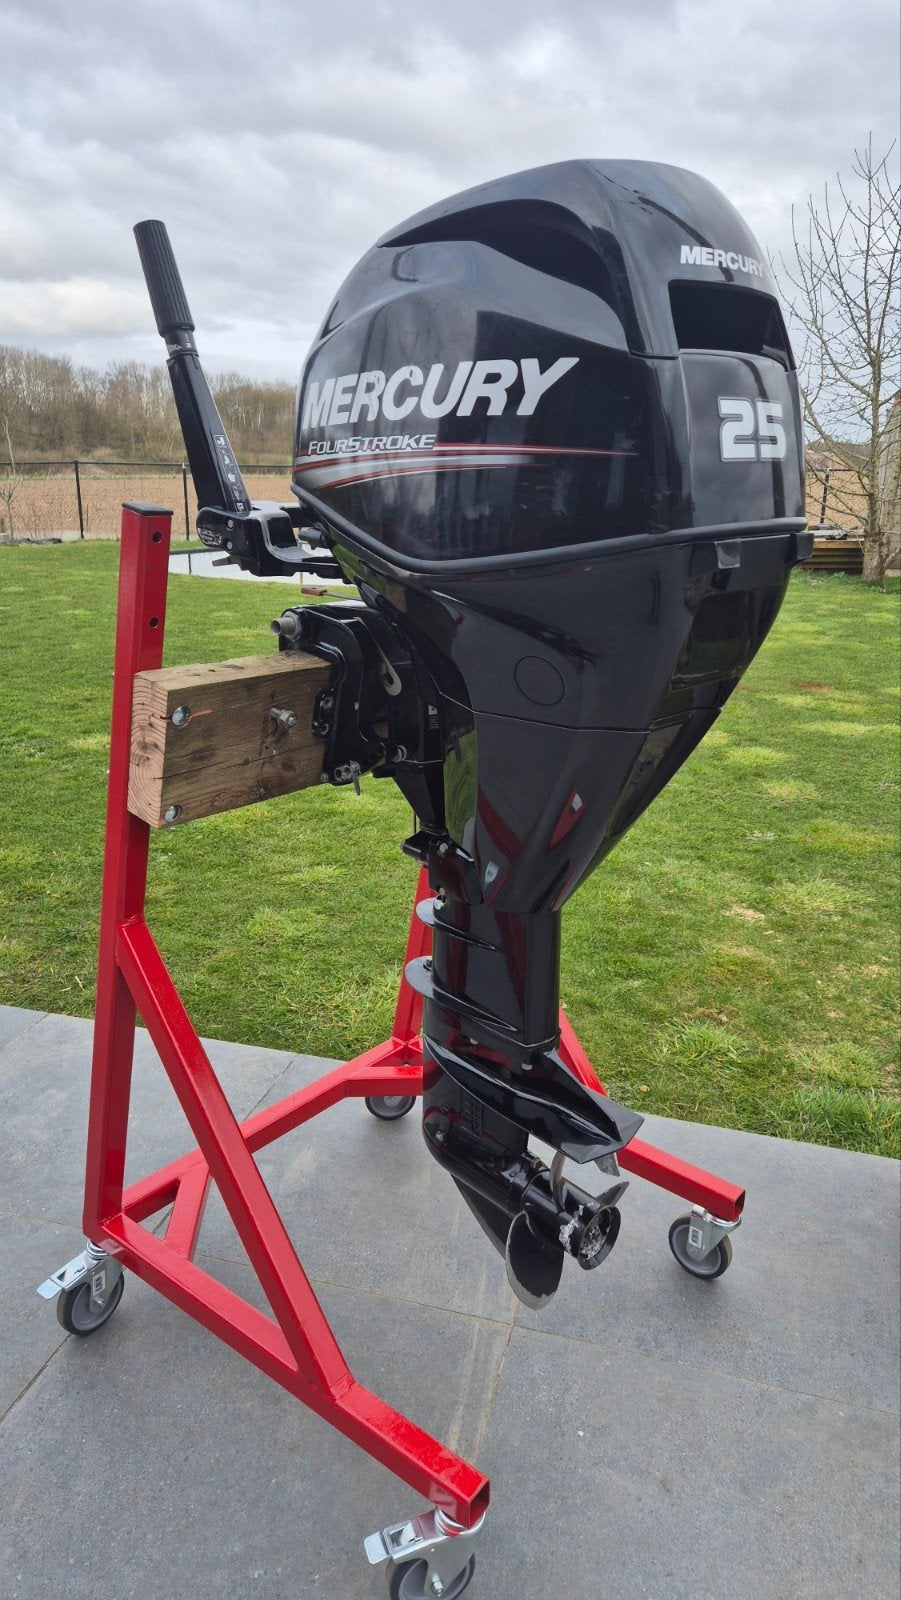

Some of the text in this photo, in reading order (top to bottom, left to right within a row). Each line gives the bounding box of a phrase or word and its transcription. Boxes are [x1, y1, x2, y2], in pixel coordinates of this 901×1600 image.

[680, 245, 763, 277] MERCURY
[302, 357, 580, 430] MERCURY
[307, 434, 437, 455] FOURSTROKE
[718, 396, 787, 462] 25
